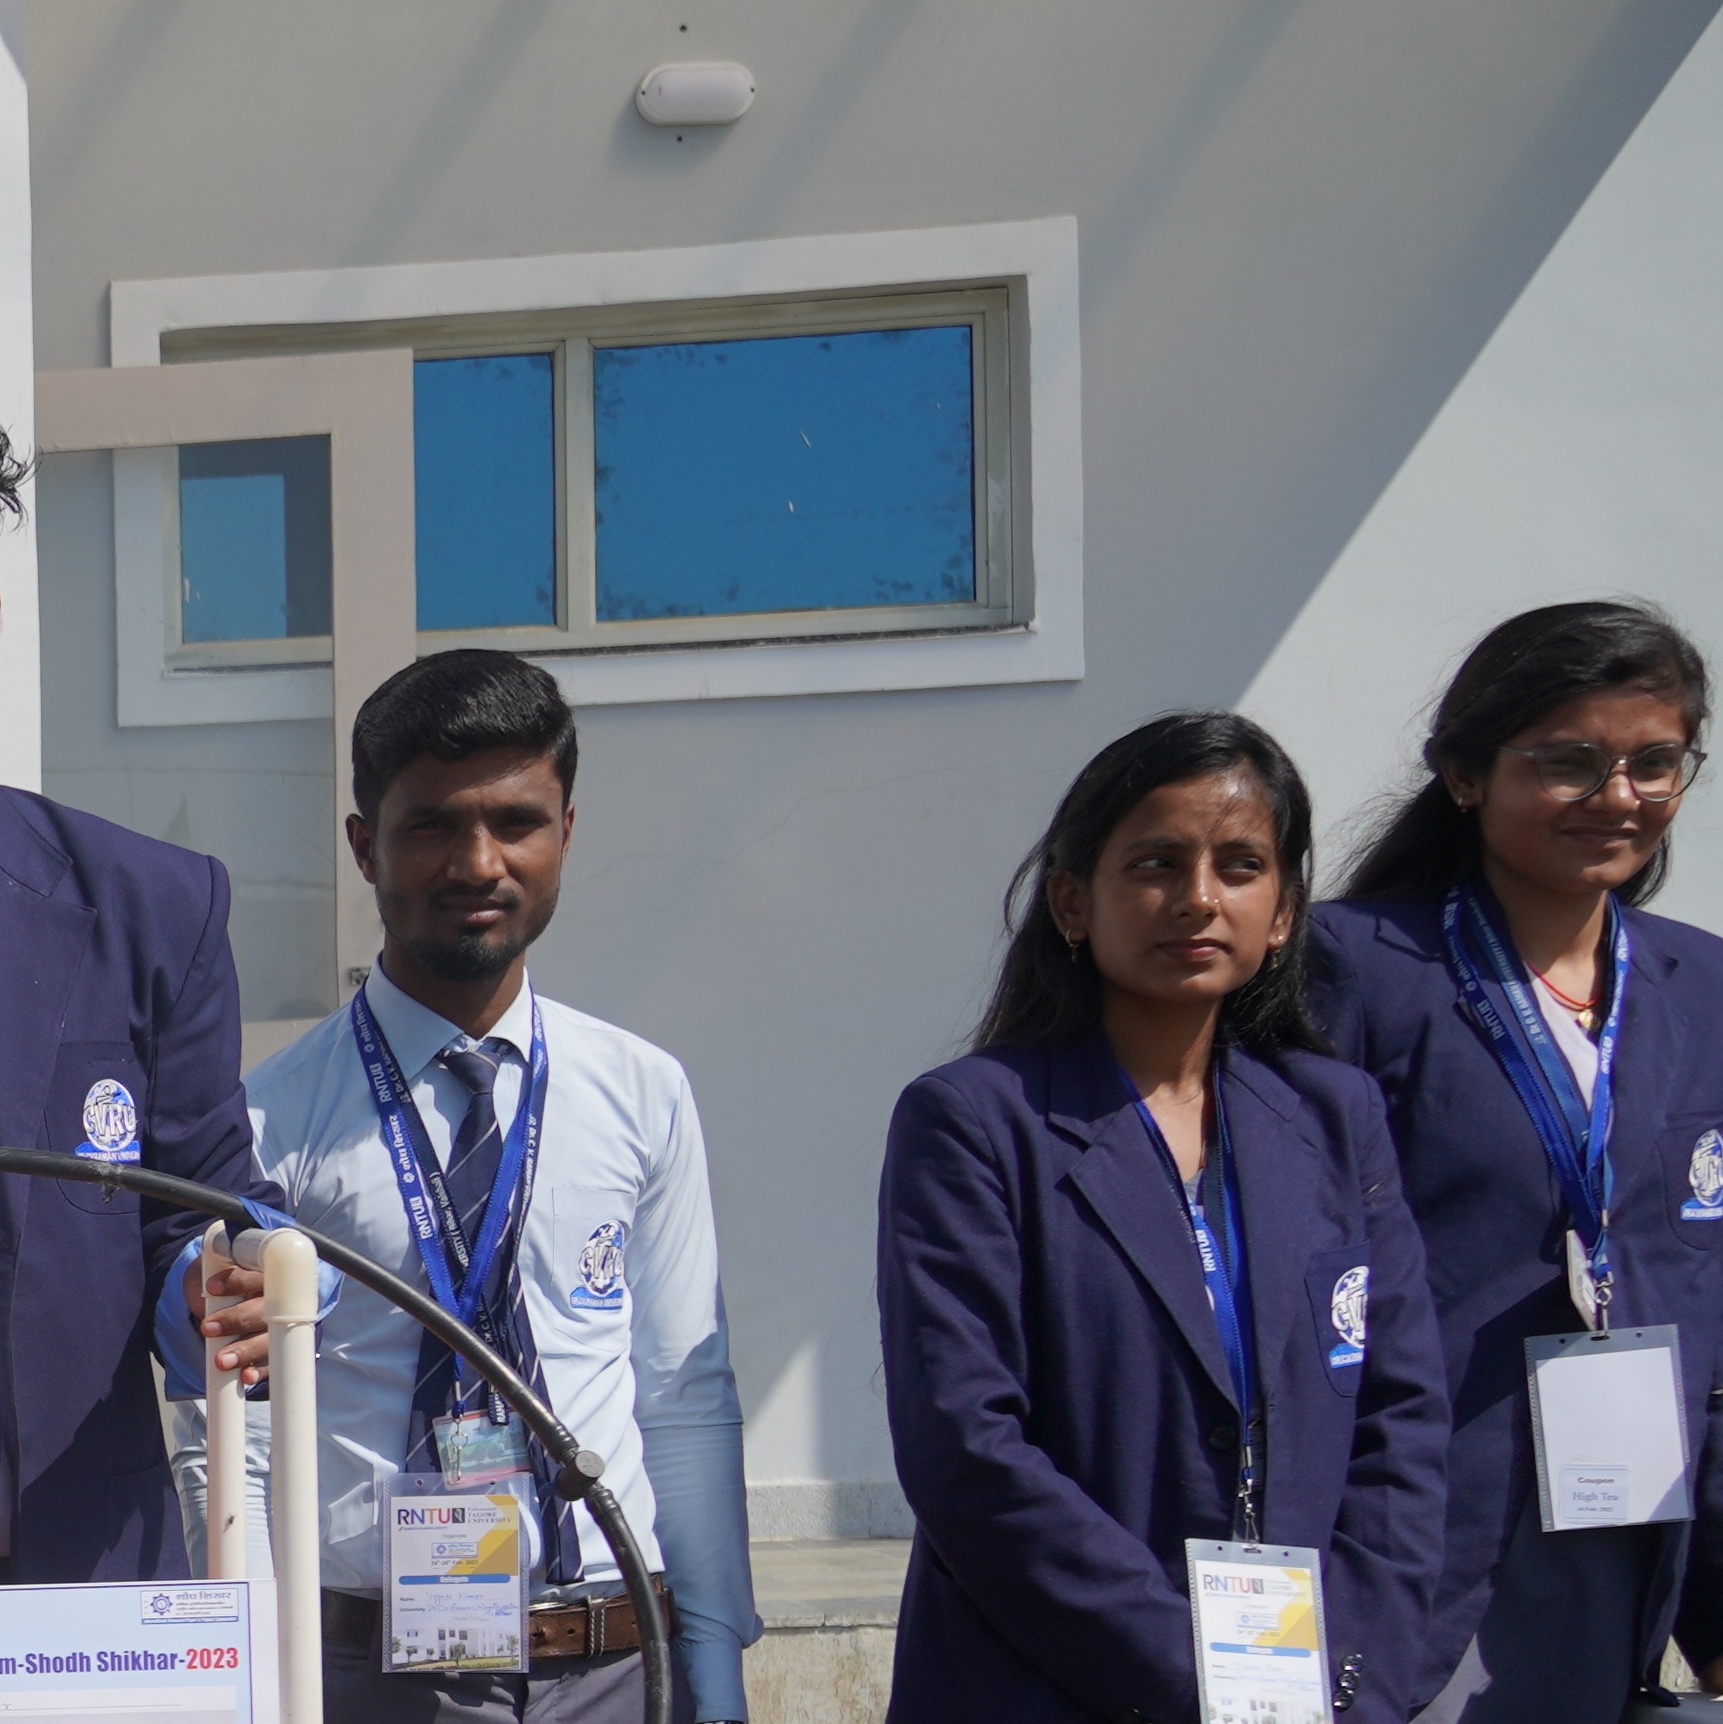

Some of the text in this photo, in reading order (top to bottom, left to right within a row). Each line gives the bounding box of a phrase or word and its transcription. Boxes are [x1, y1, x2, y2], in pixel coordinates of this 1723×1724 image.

[372, 1071, 393, 1103] RNTU
[83, 1103, 136, 1136] CVRU
[413, 1203, 433, 1239] RNTU
[398, 1508, 451, 1525] RNTU
[1203, 1574, 1252, 1594] RNTU
[97, 1647, 239, 1673] Shikhar-2023
